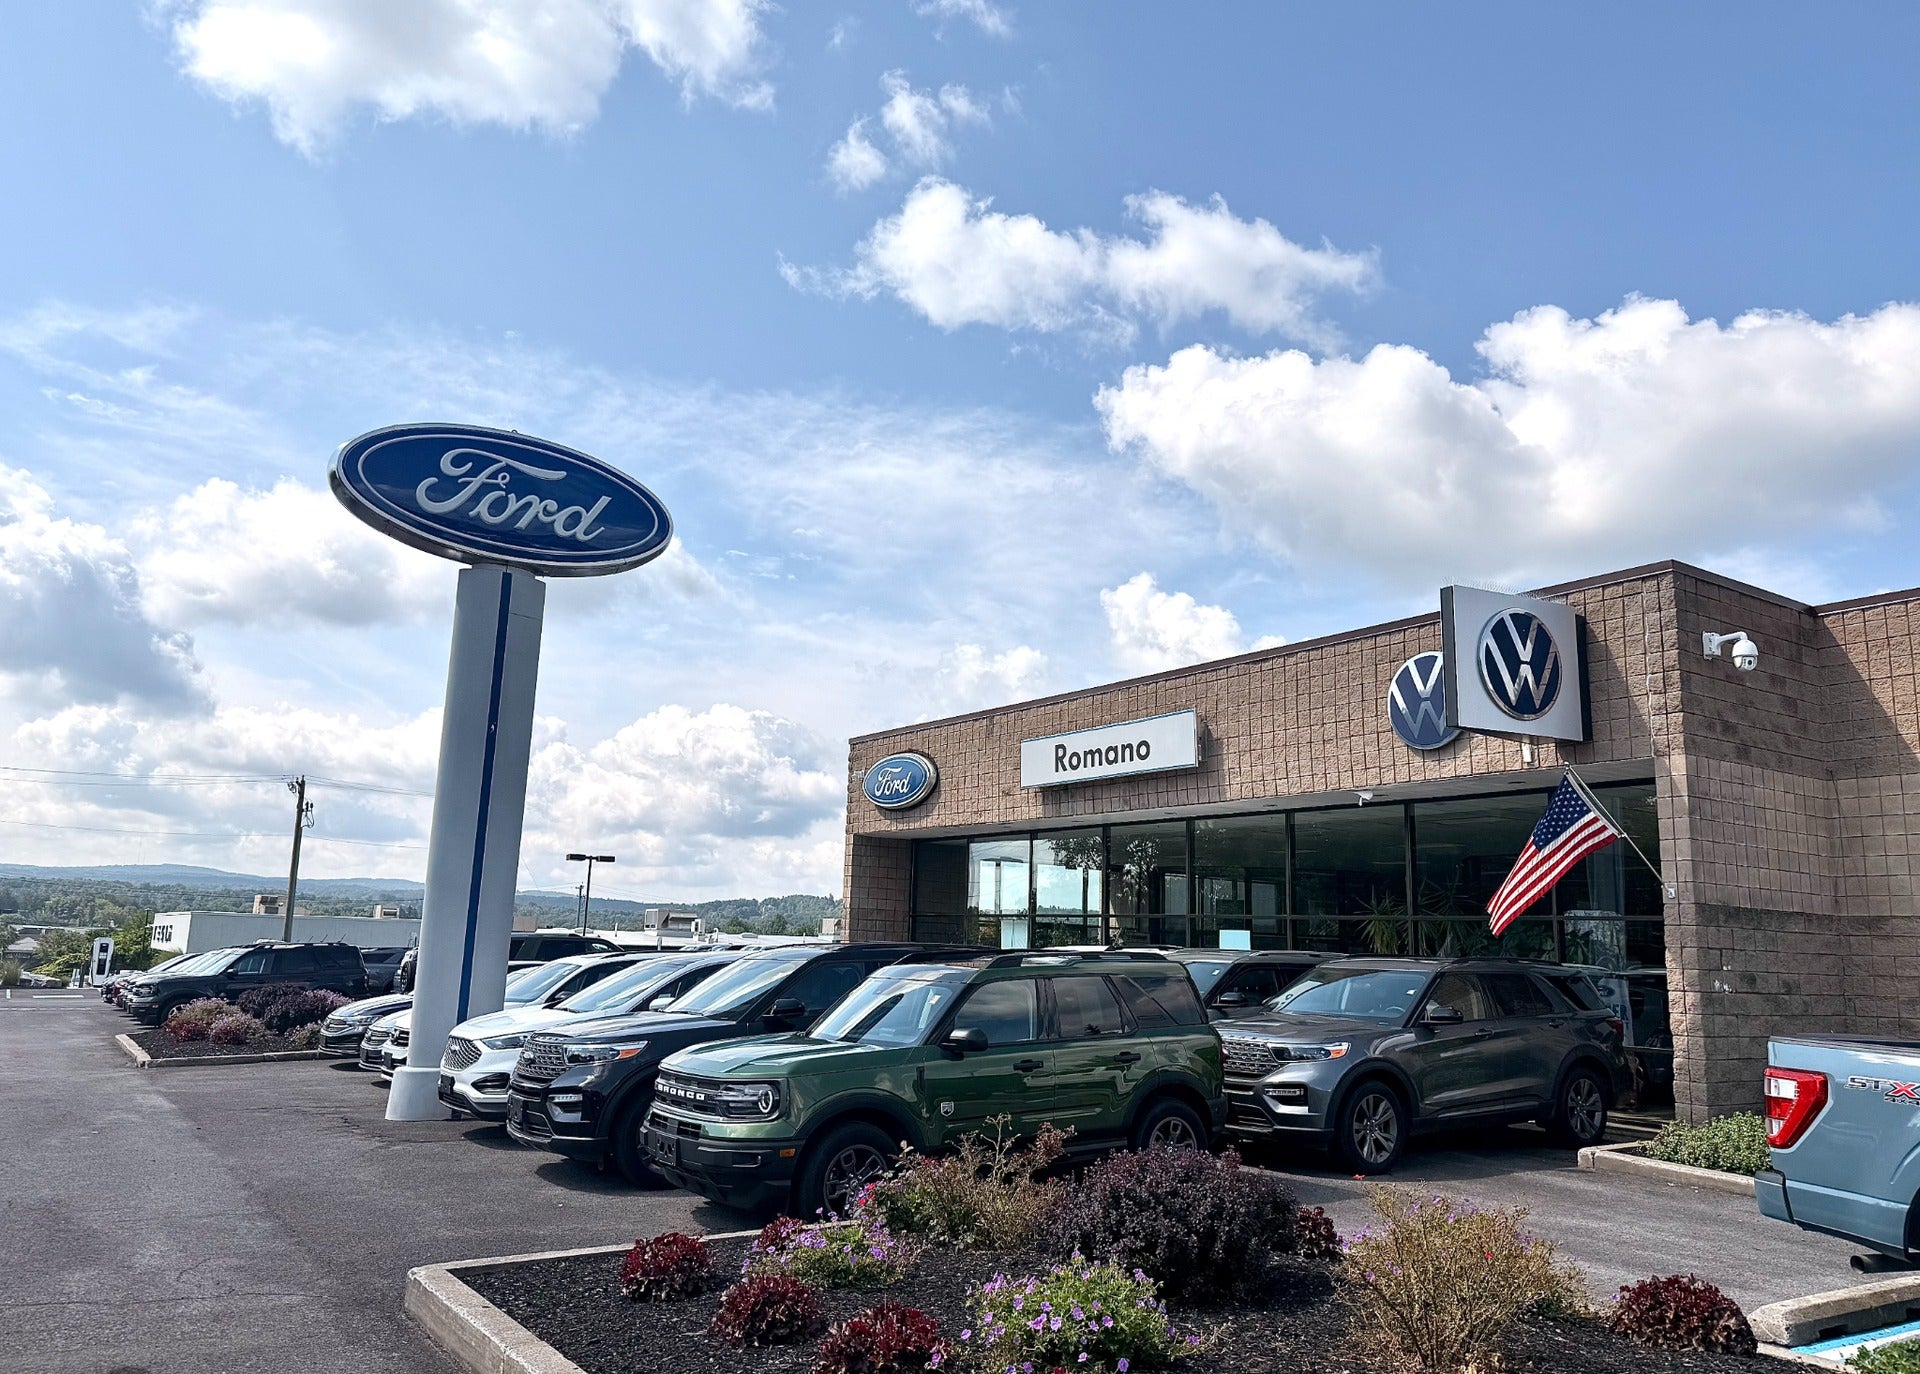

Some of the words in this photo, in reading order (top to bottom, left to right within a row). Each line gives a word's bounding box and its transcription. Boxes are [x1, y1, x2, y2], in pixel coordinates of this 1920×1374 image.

[415, 448, 612, 542] Ford
[1054, 739, 1151, 773] Romano
[874, 766, 912, 797] Ford
[657, 1083, 706, 1101] BRONCO
[1844, 1075, 1920, 1100] STX
